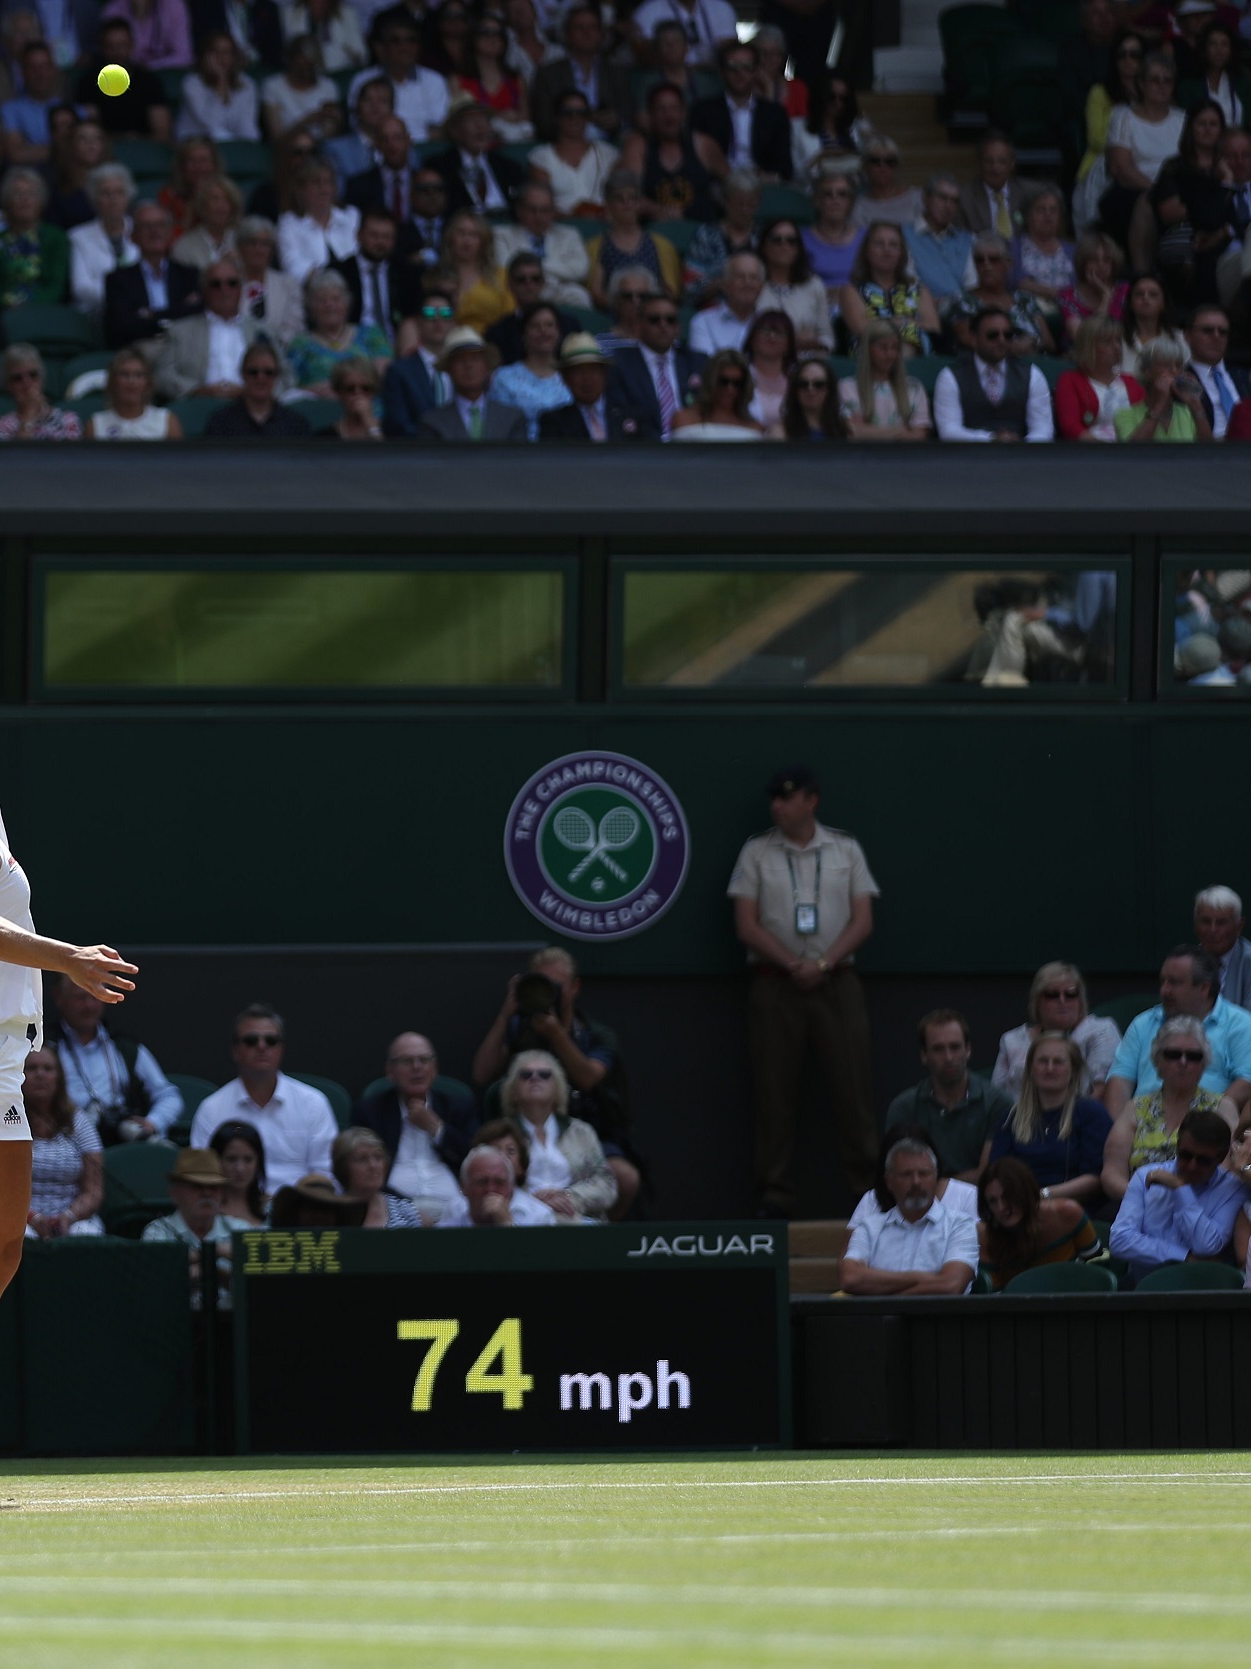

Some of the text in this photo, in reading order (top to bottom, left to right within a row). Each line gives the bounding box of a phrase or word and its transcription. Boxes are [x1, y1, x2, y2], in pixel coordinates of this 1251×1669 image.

[515, 760, 679, 842] THE CHAMPIONSHIPS
[539, 887, 661, 931] WIMBLEDON
[243, 1232, 341, 1273] IBM
[627, 1234, 775, 1257] JAGUAR
[396, 1317, 692, 1424] 74 mph
